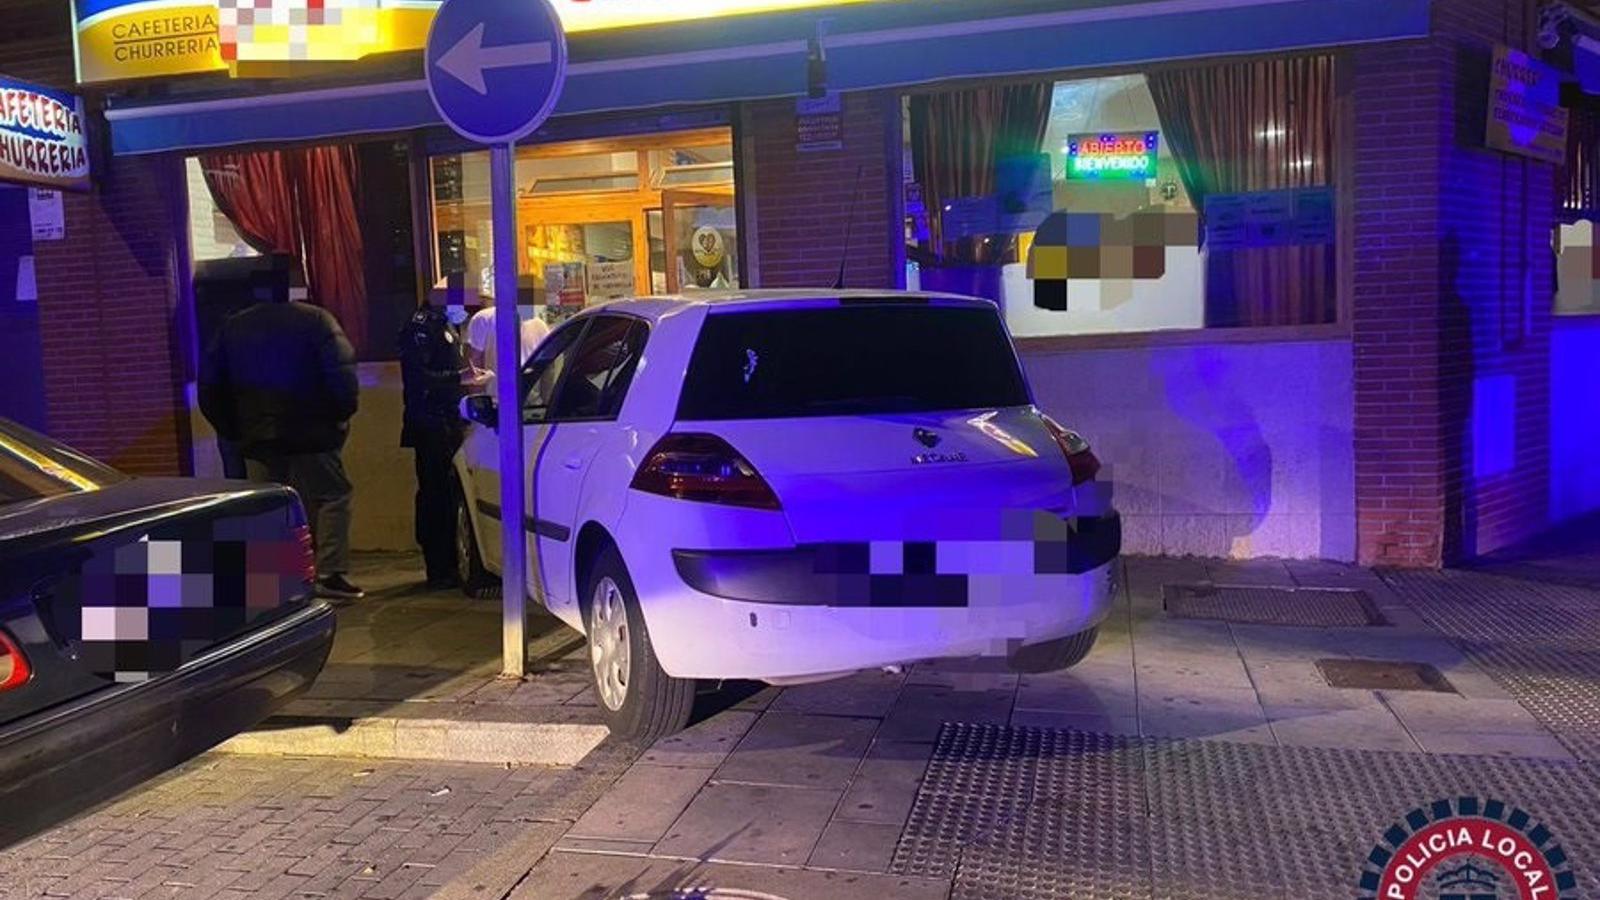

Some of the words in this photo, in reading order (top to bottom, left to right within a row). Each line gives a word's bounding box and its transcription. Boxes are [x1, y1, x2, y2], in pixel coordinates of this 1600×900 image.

[112, 14, 216, 39] CAFETERIA
[114, 36, 218, 62] CHURRERIA
[0, 90, 82, 135] AFETERIA
[0, 133, 86, 174] HURRERIA
[1080, 140, 1147, 154] ABIERTO
